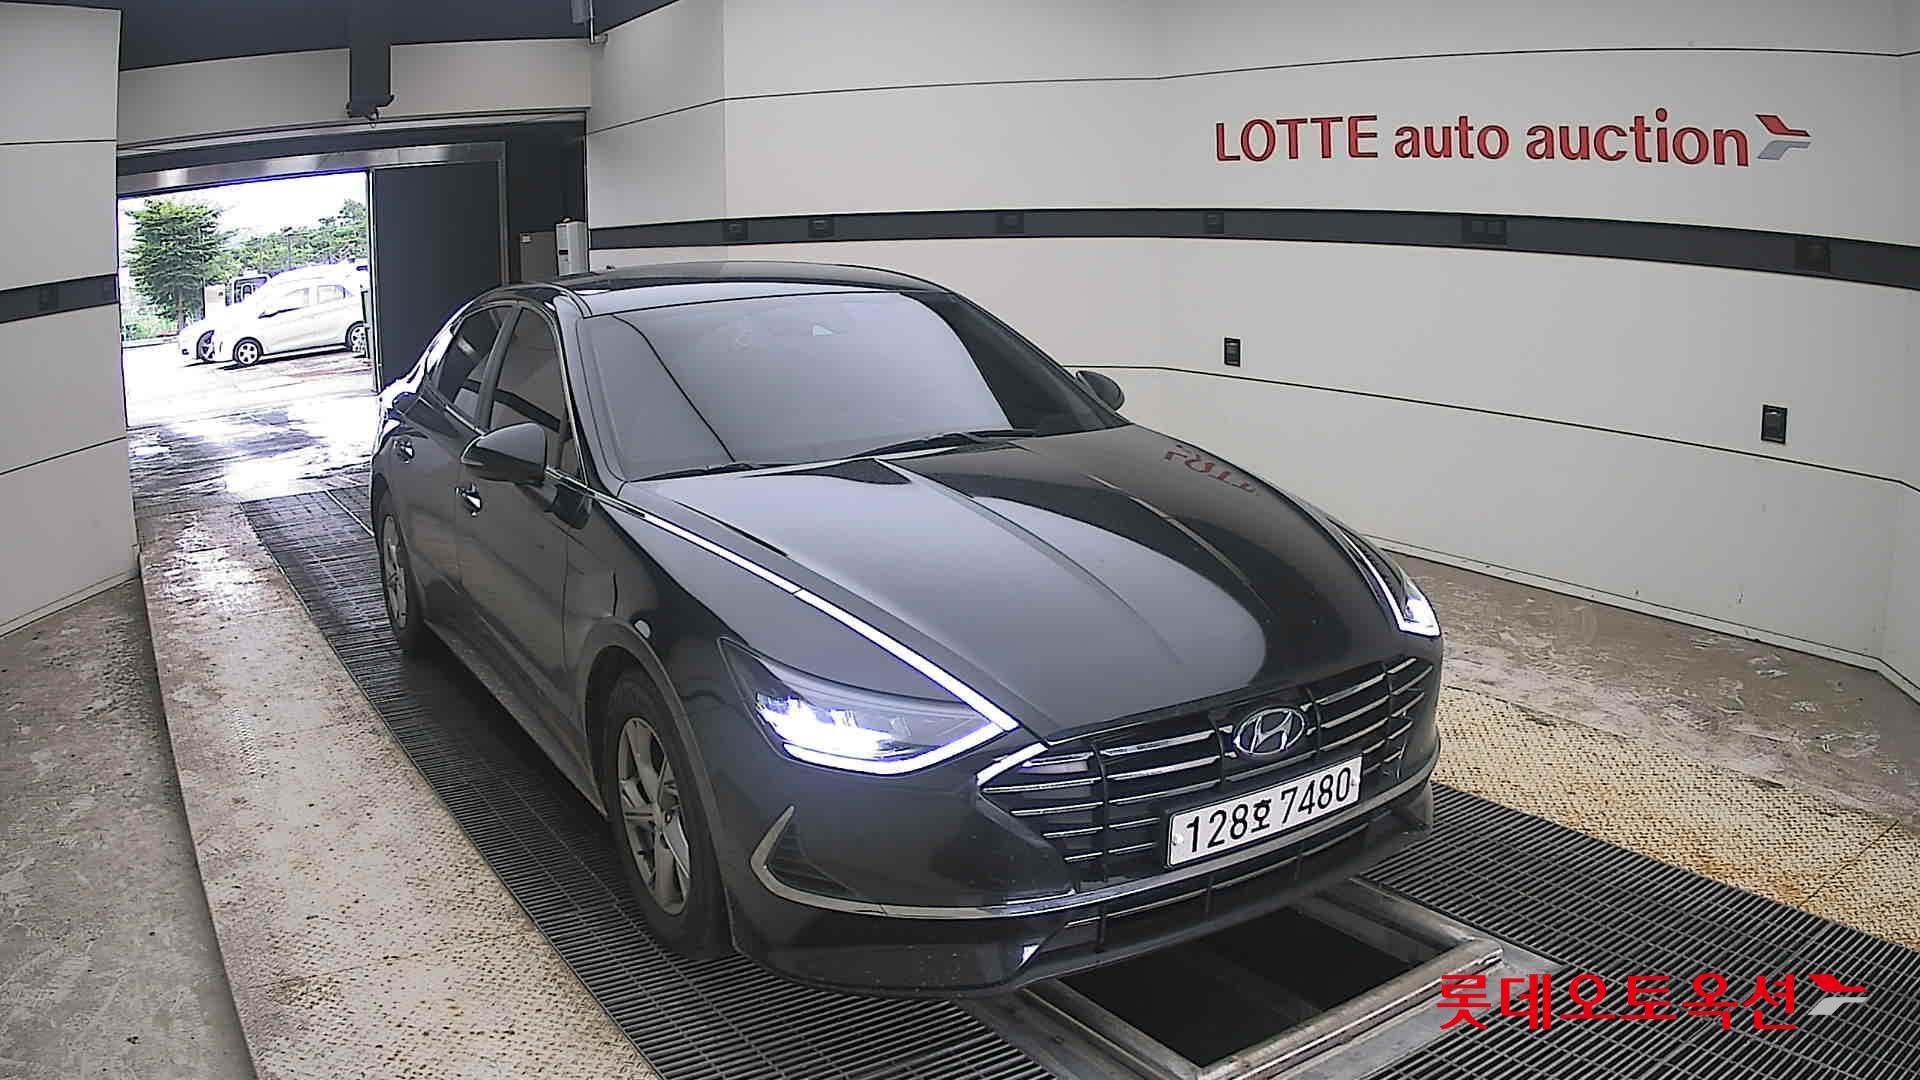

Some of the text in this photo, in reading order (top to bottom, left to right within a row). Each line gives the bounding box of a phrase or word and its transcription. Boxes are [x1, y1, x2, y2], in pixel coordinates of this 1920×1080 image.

[1216, 107, 1750, 167] LOTTE auto auction
[1186, 767, 1351, 853] 128호 7480
